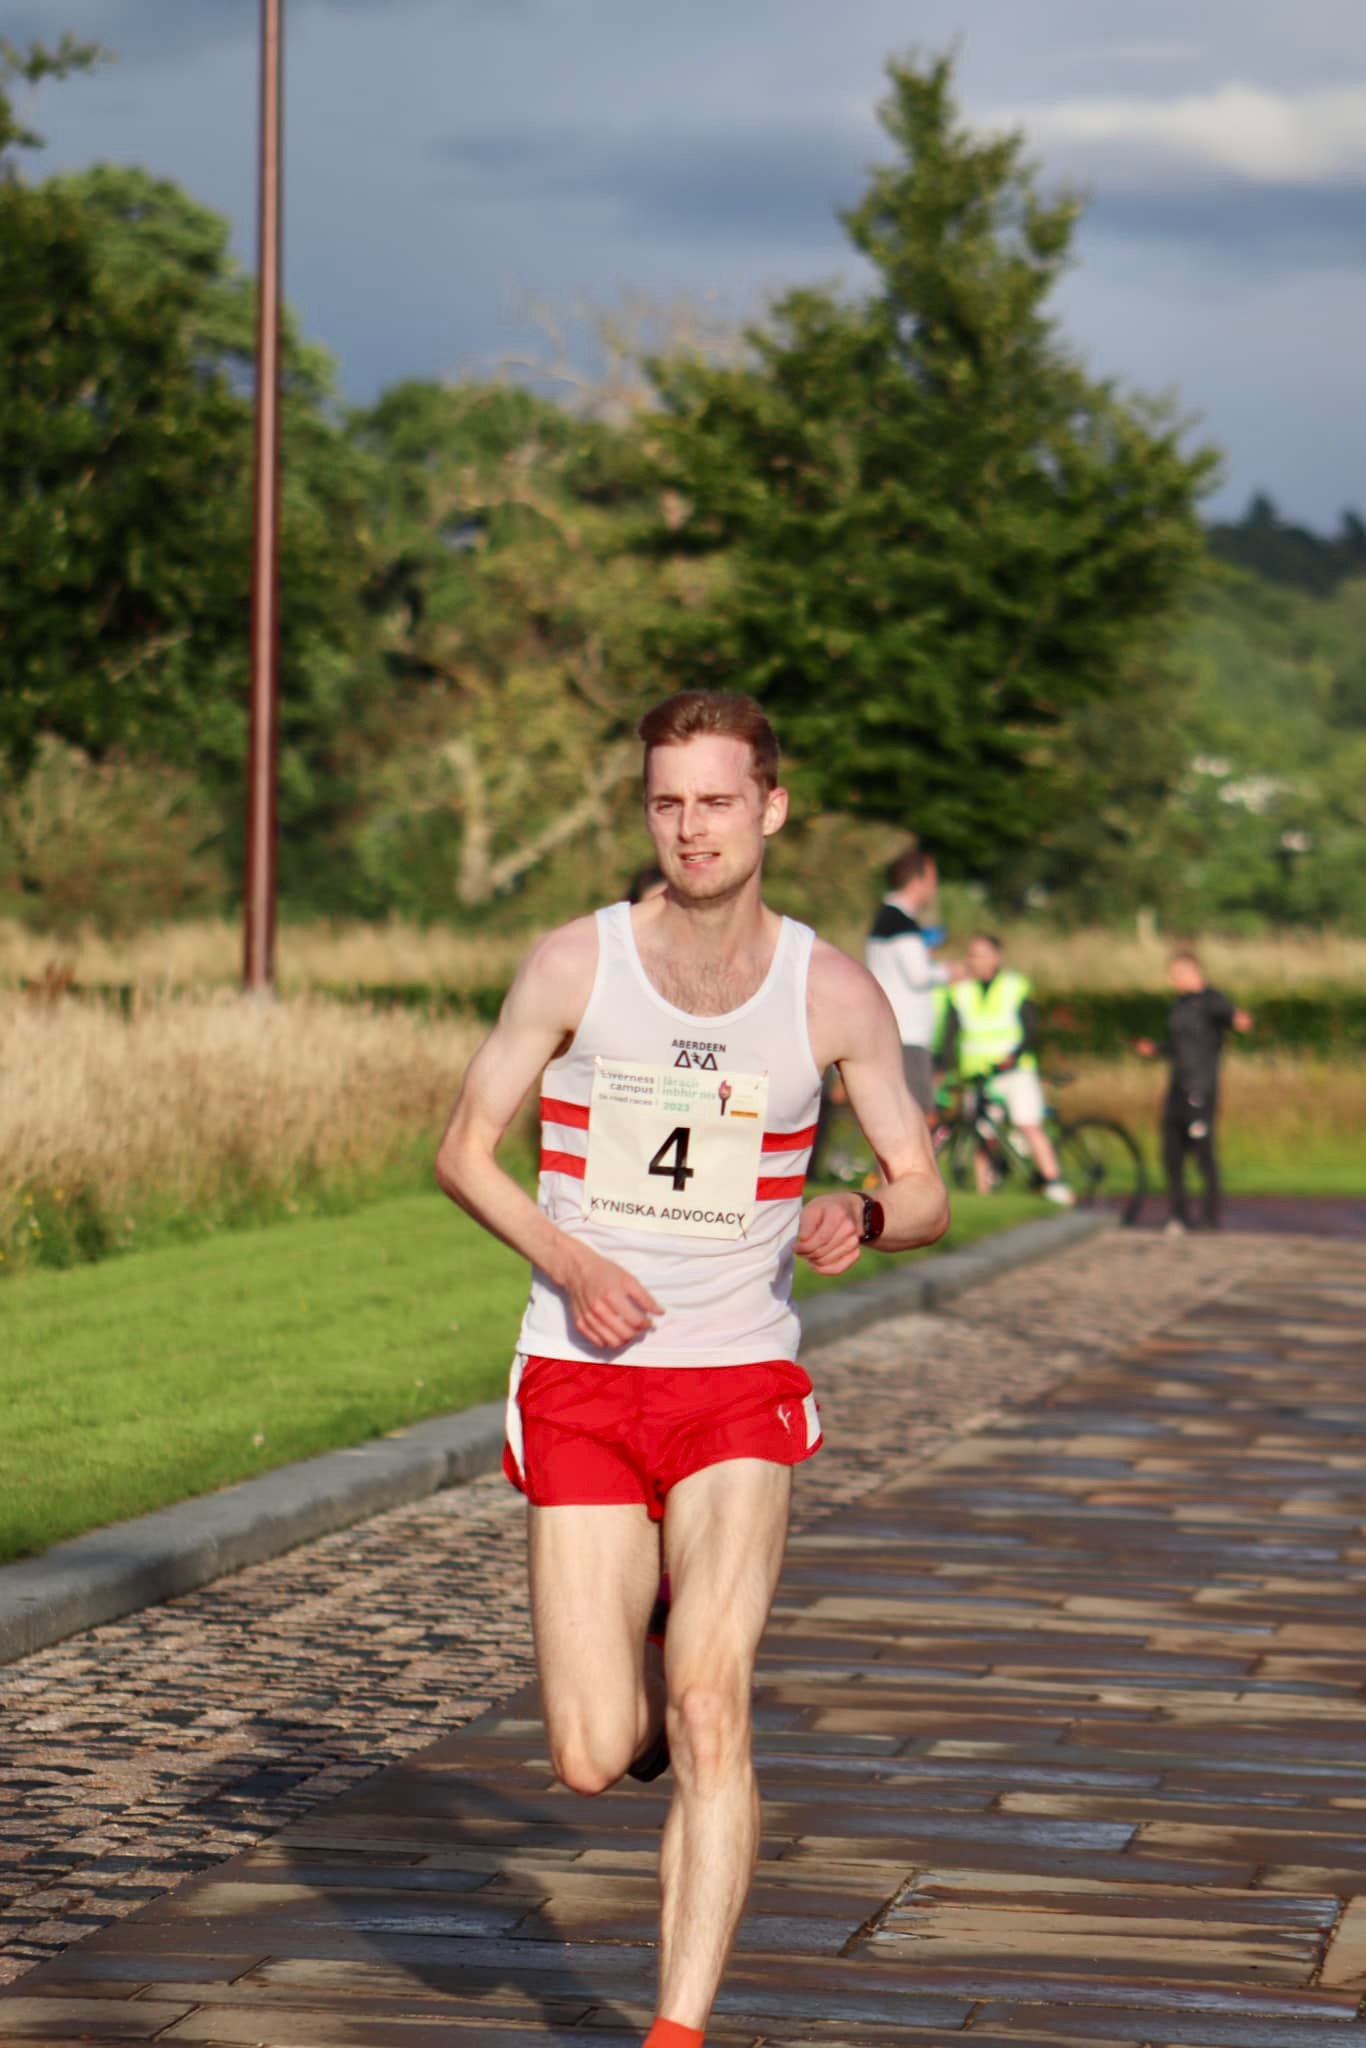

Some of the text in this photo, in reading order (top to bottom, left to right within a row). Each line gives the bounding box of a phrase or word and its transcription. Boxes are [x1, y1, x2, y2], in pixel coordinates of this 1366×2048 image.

[671, 1039, 726, 1053] ABERDEEN
[609, 1082, 654, 1095] campus
[648, 1127, 694, 1192] 4
[590, 1196, 746, 1226] KYNISKA ADVOCACY
